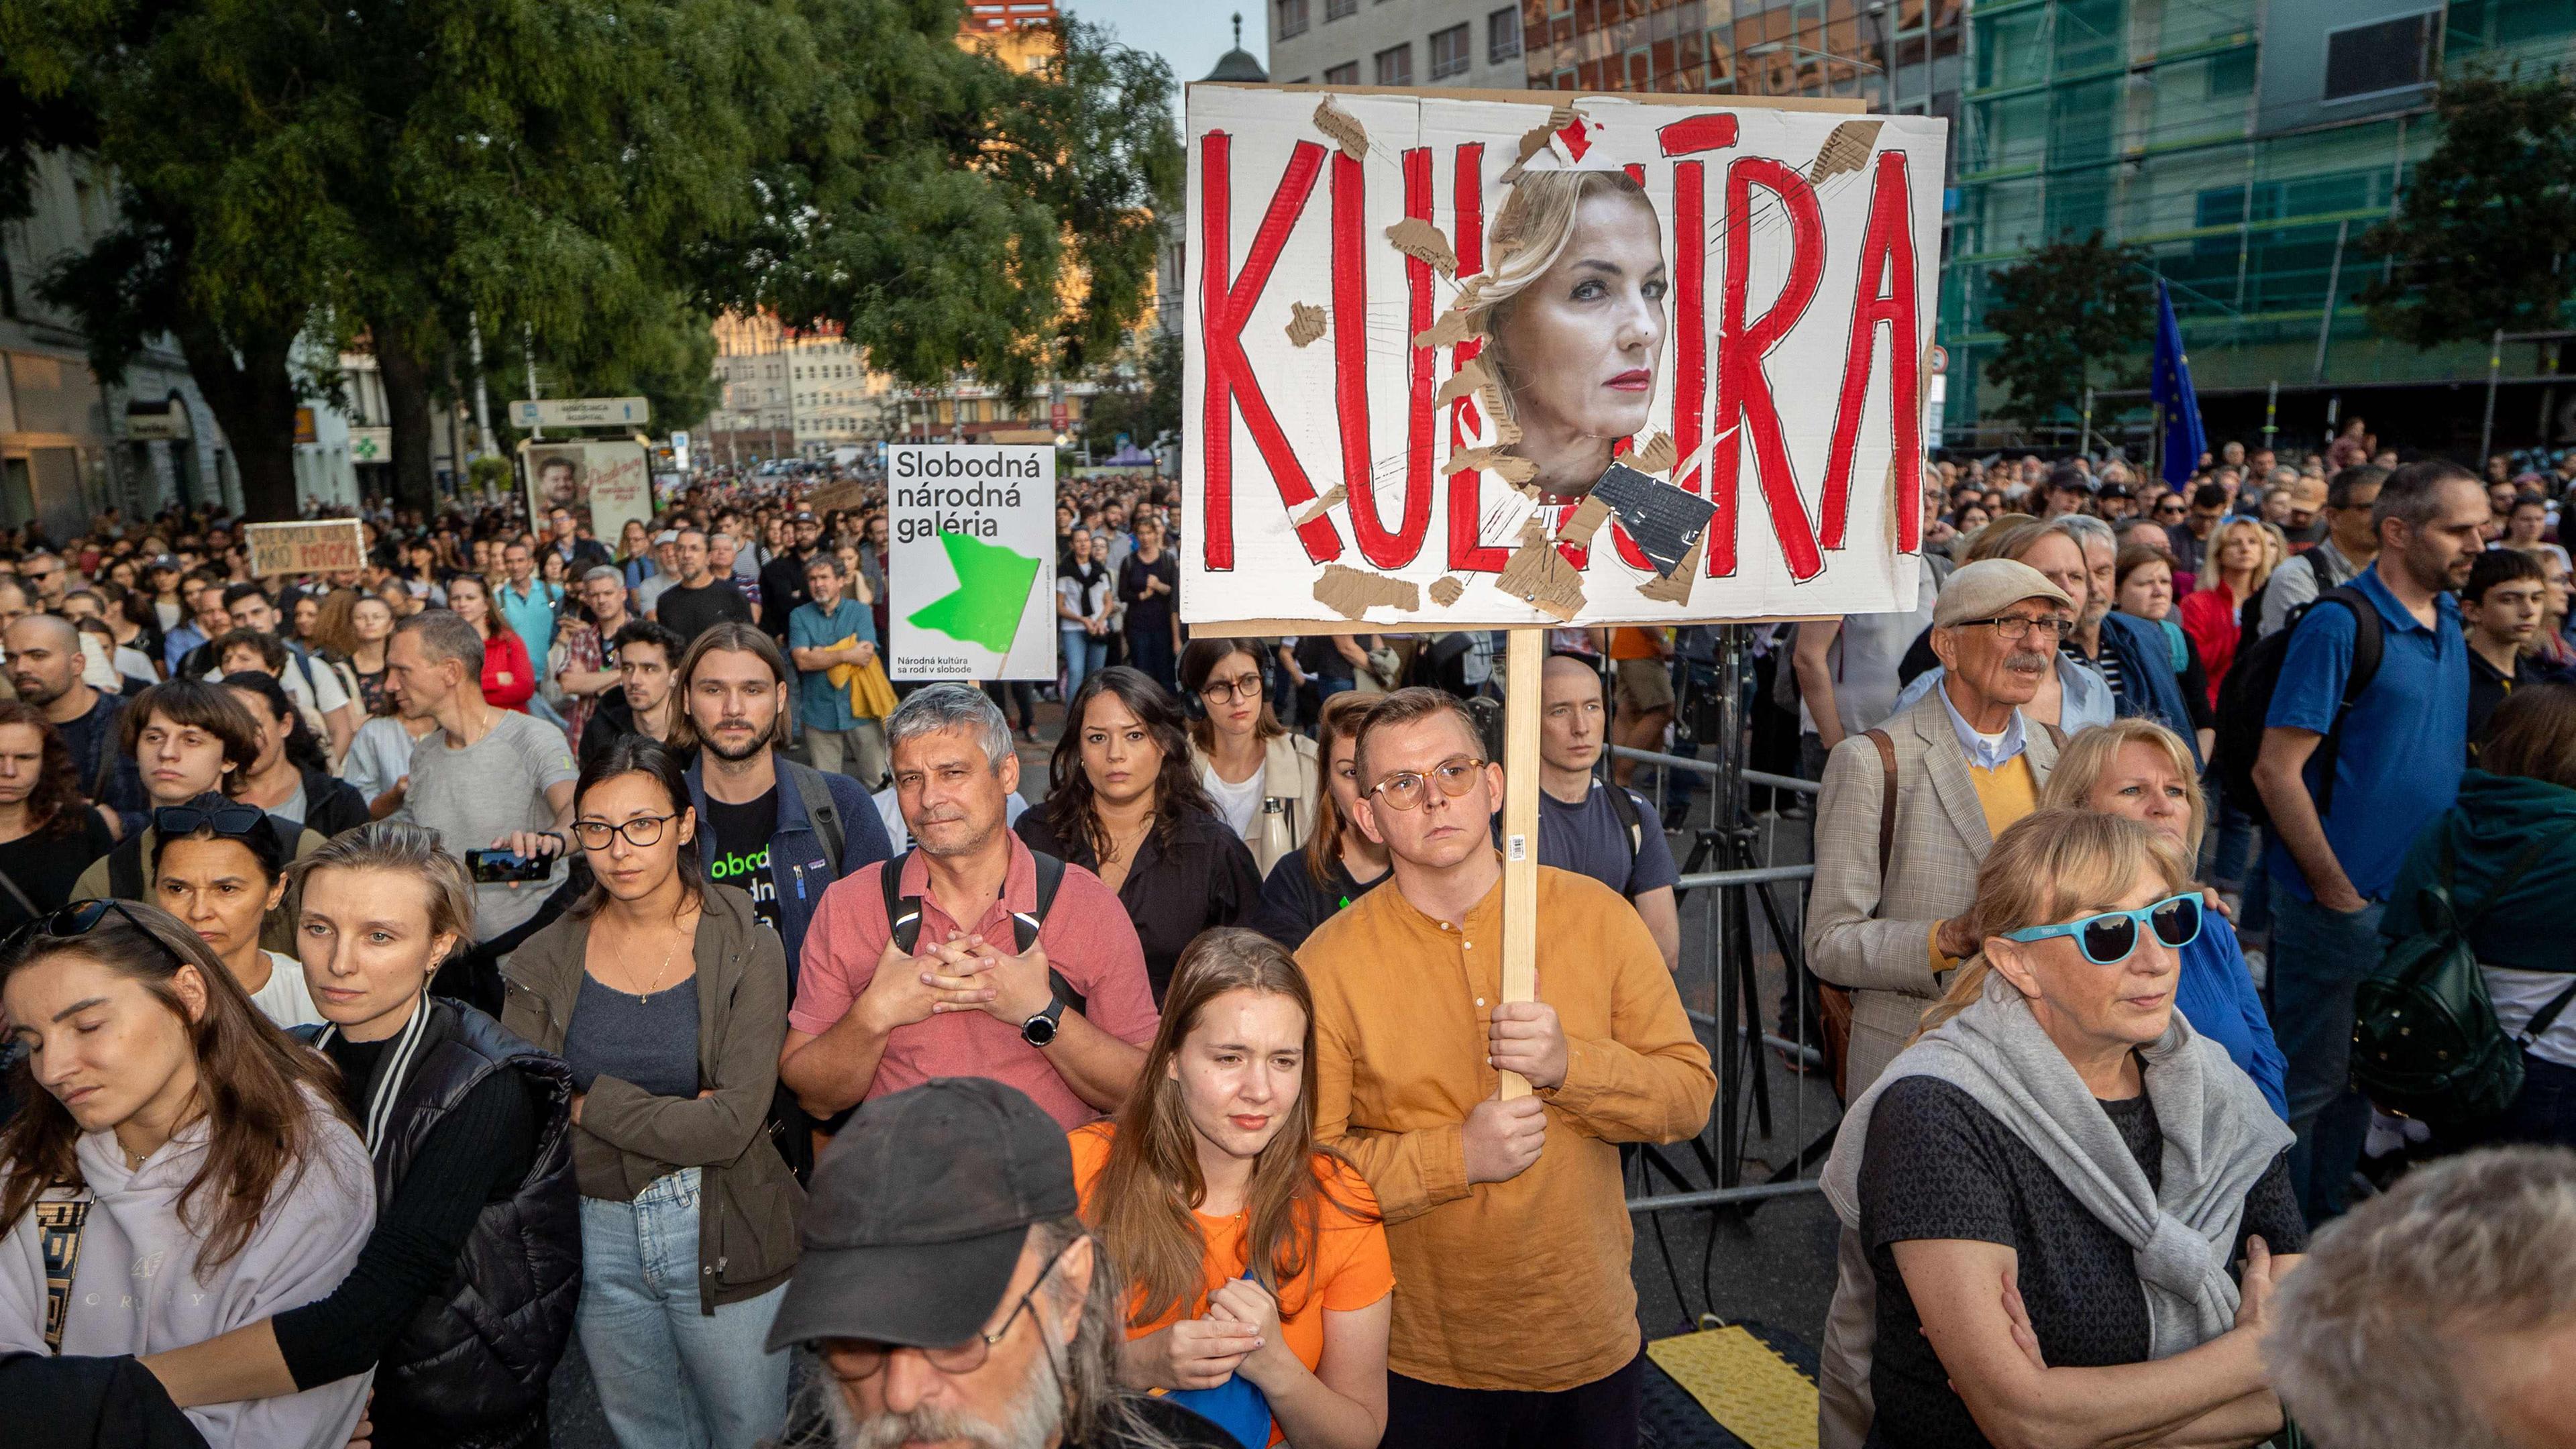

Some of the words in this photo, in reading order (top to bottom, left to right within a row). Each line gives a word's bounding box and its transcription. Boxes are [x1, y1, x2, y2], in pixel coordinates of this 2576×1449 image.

[897, 451, 1040, 478] Slobodná
[898, 481, 1020, 507] národná
[898, 511, 998, 544] galéria
